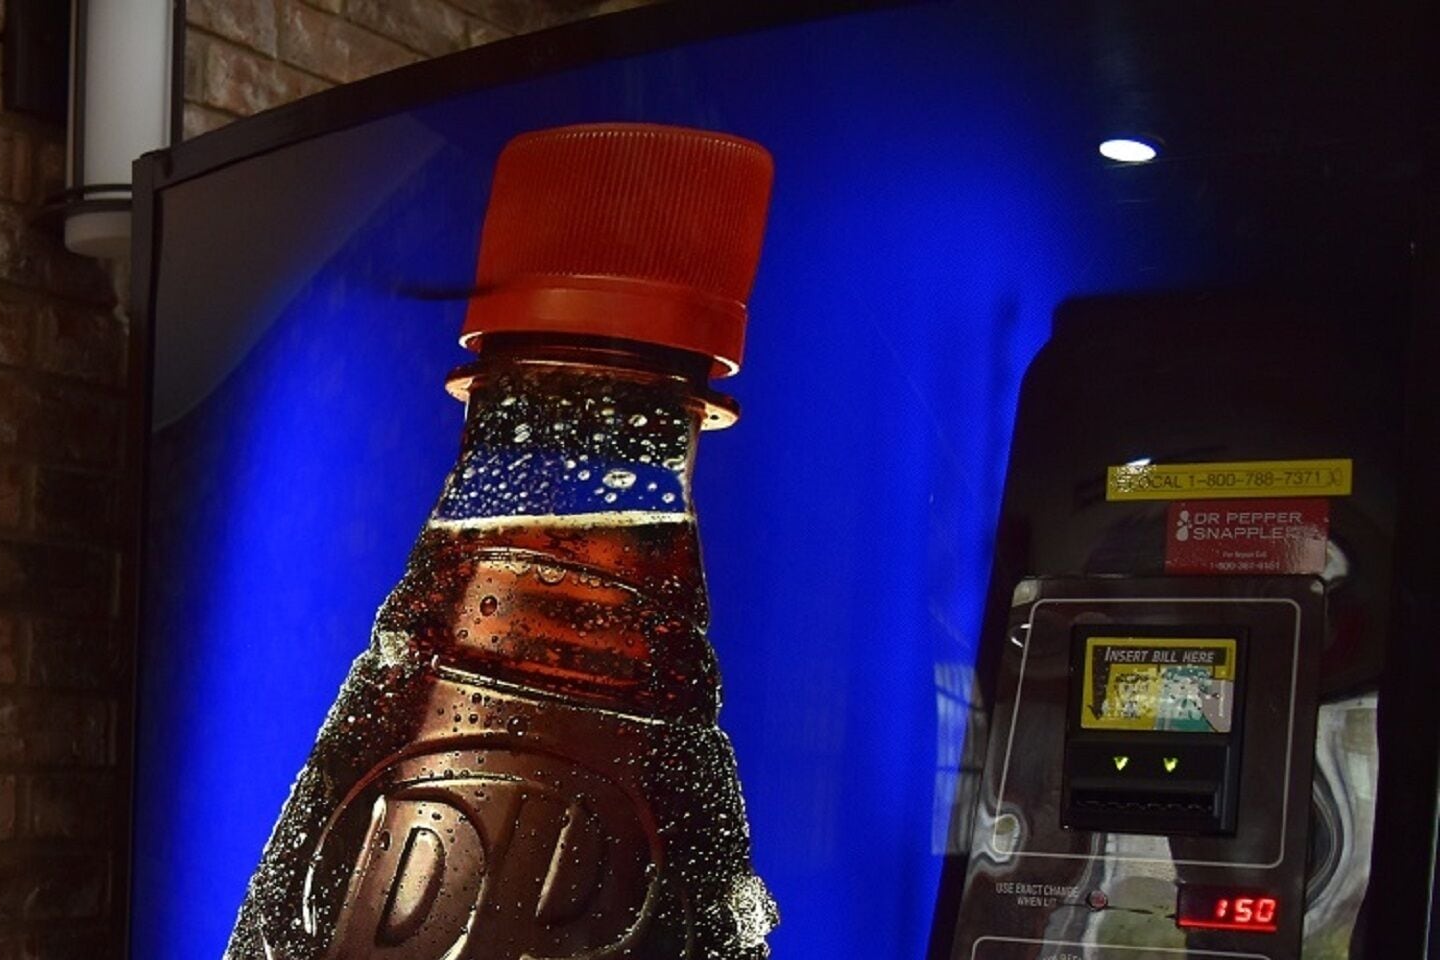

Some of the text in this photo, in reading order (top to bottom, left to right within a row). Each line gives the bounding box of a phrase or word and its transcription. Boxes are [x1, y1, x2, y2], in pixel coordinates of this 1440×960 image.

[1188, 470, 1321, 488] 1-800-788-7371
[1194, 512, 1303, 525] DR PEPPER
[1193, 527, 1286, 540] SNAPPLE
[1104, 646, 1215, 662] INSERT BILL HERE
[995, 882, 1014, 894] USE
[1015, 882, 1043, 896] EXACT
[1017, 896, 1043, 907] WHEN
